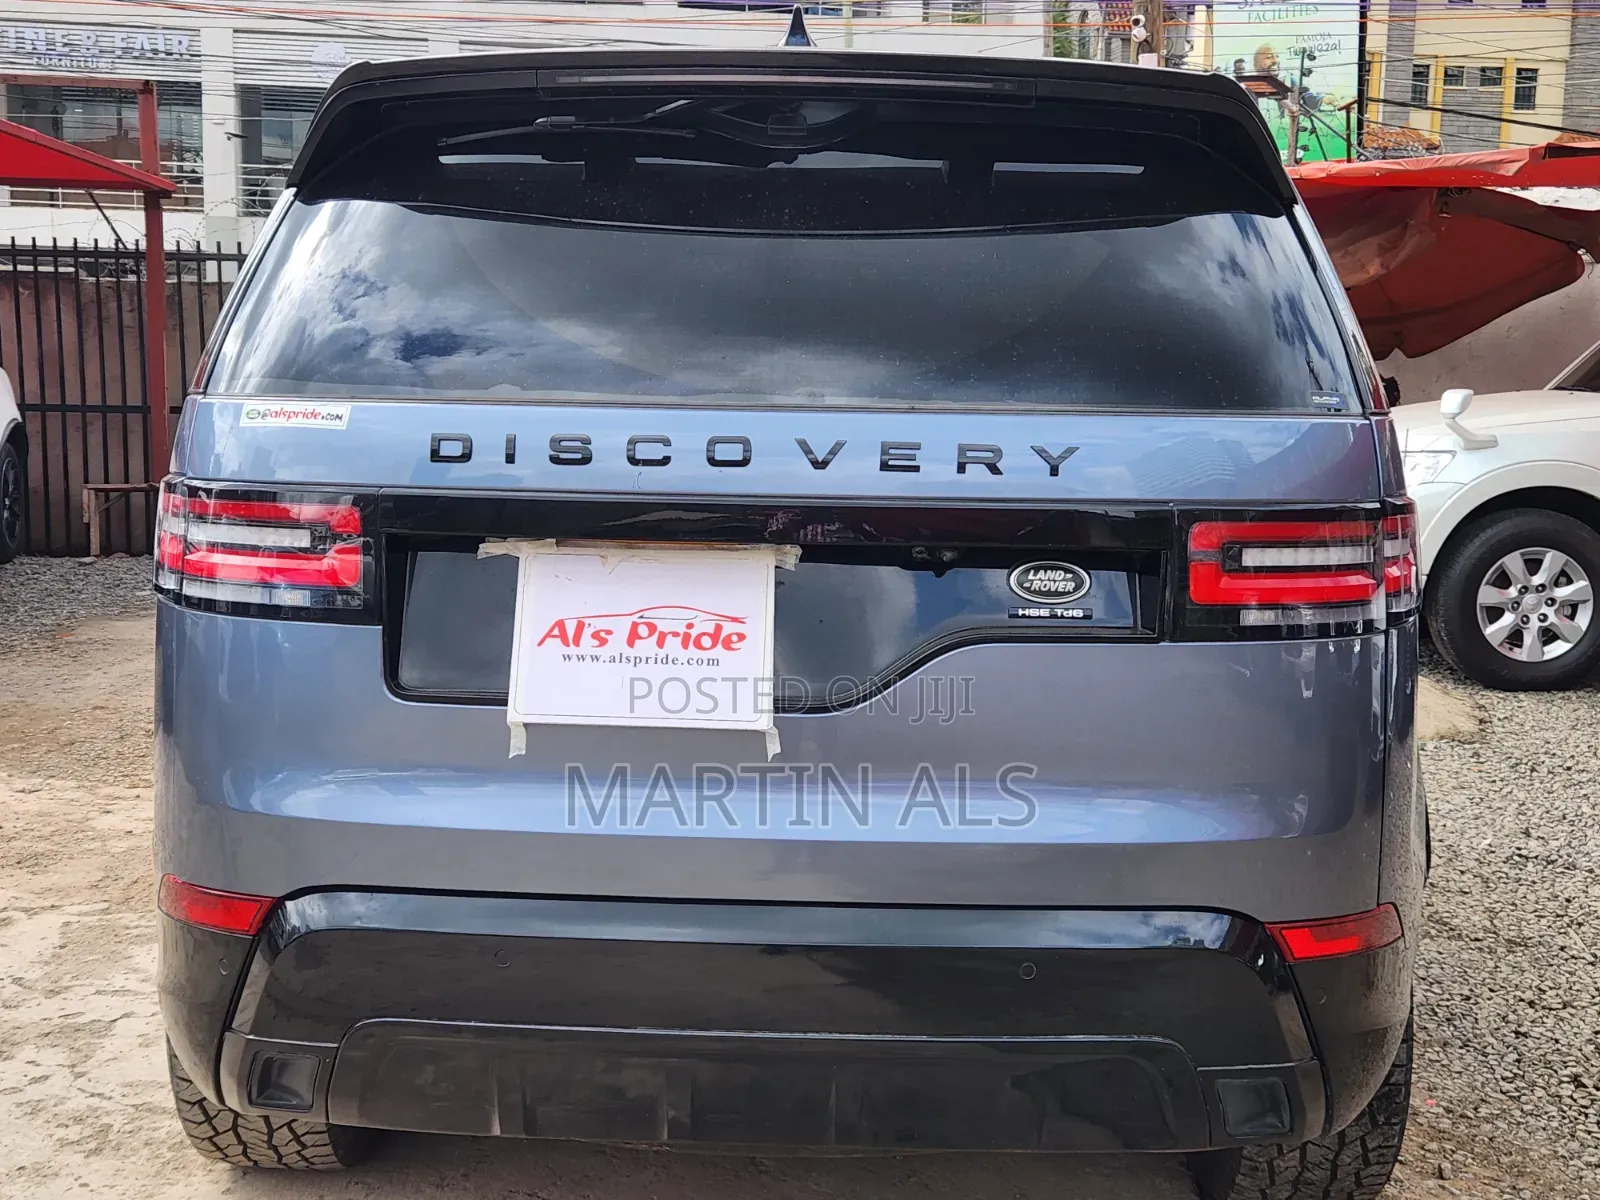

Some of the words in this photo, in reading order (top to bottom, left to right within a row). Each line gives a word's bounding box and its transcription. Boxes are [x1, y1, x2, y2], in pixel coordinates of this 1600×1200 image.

[1247, 4, 1319, 23] FACILITIES
[0, 27, 70, 52] INE
[114, 33, 191, 59] FAIR
[1286, 39, 1342, 57] Twweza!
[429, 431, 1080, 478] DISCOVERY
[1027, 569, 1065, 580] LAND
[1030, 580, 1076, 592] ROVER
[1018, 608, 1050, 617] HSE
[1054, 609, 1084, 618] Td6
[537, 619, 614, 648] Al's
[626, 620, 747, 651] Pride
[561, 652, 721, 667] www.alspride.com
